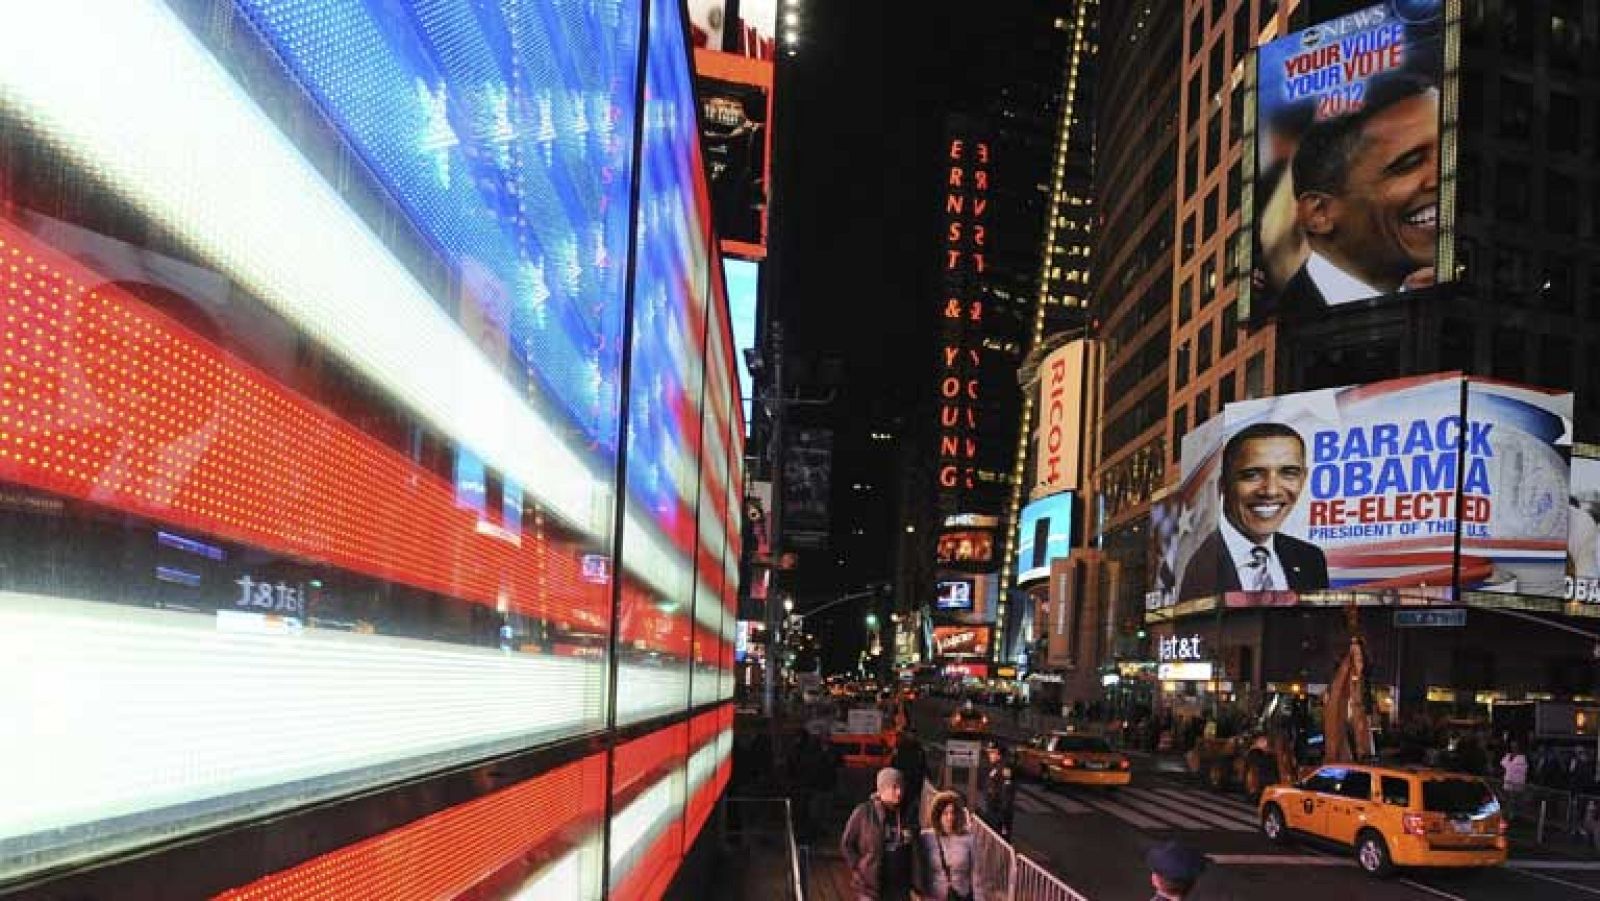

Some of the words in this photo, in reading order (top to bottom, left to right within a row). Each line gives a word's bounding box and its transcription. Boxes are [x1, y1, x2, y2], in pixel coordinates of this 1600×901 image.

[1323, 4, 1385, 39] NEWS
[1285, 44, 1340, 78] YOUR
[1342, 24, 1404, 59] VOICE
[1286, 65, 1341, 100] YOUR
[1344, 44, 1402, 82] VOTE
[1317, 82, 1365, 118] 2012
[947, 139, 963, 270] ERNST
[944, 298, 960, 318] &
[940, 346, 959, 488] YOUNG
[1047, 358, 1065, 484] RICOH
[1313, 415, 1494, 463] BARACK
[1310, 453, 1491, 499] OBAMA
[1308, 524, 1393, 540] PRESIDENT
[1400, 522, 1422, 535] OF
[1309, 492, 1491, 526] RE-ELECTED
[1162, 633, 1201, 660] at&t
